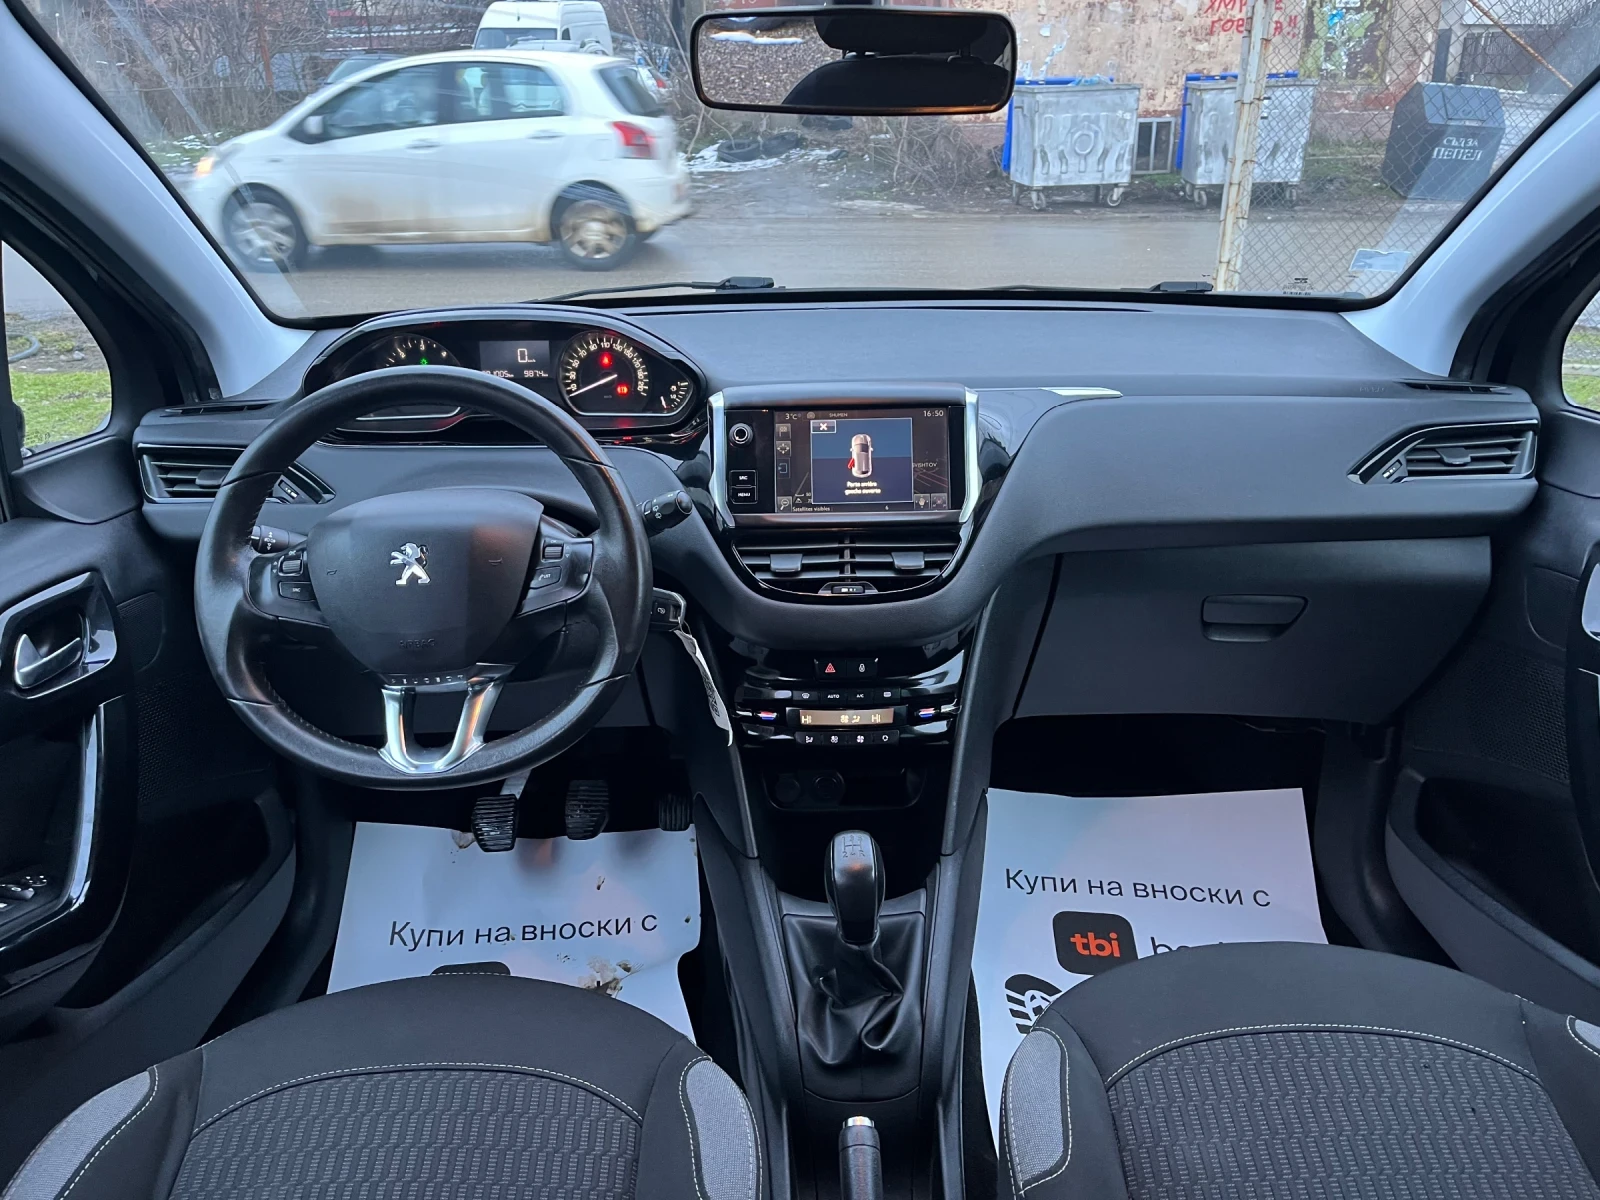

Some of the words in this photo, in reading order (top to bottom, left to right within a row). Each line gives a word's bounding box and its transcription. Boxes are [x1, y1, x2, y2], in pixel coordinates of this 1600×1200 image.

[1431, 146, 1483, 161] ПЕПЕЛ
[612, 343, 623, 352] 130
[579, 350, 587, 358] 70
[623, 348, 634, 359] 150
[572, 359, 580, 368] 50
[632, 357, 640, 369] 170
[569, 371, 576, 380] 30
[923, 409, 944, 418] 16:50
[801, 715, 812, 724] HI
[871, 714, 881, 724] HI
[1005, 867, 1078, 895] Купи
[1086, 878, 1125, 897] на
[1132, 880, 1245, 906] вноски
[1252, 888, 1272, 907] с
[389, 920, 465, 952] Купи
[474, 923, 511, 945] на
[521, 915, 634, 941] вноски
[640, 912, 659, 932] с
[1069, 931, 1121, 958] tbi
